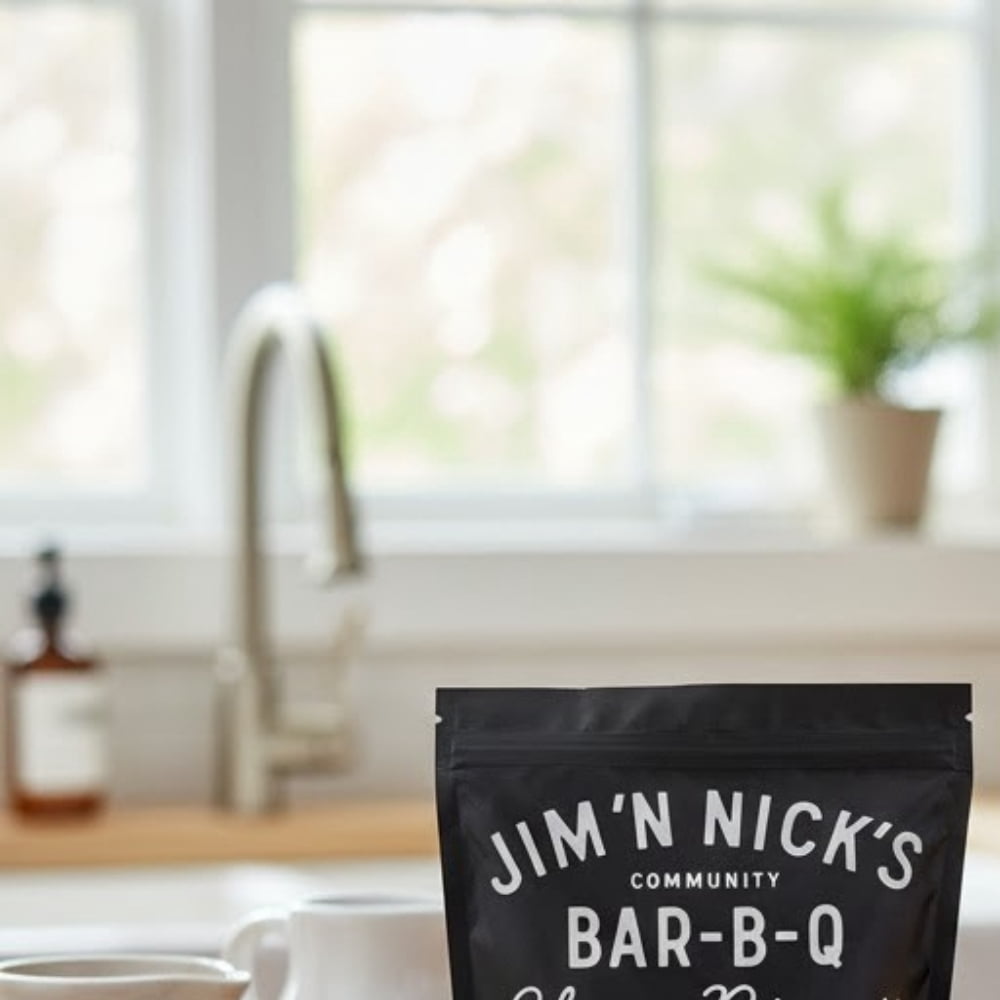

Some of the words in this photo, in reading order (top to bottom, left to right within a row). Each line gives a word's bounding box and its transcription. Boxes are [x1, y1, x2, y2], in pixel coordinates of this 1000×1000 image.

[700, 789, 922, 890] NICK'S
[631, 872, 779, 889] COMMUNITY
[568, 904, 843, 969] BAR-B-Q
